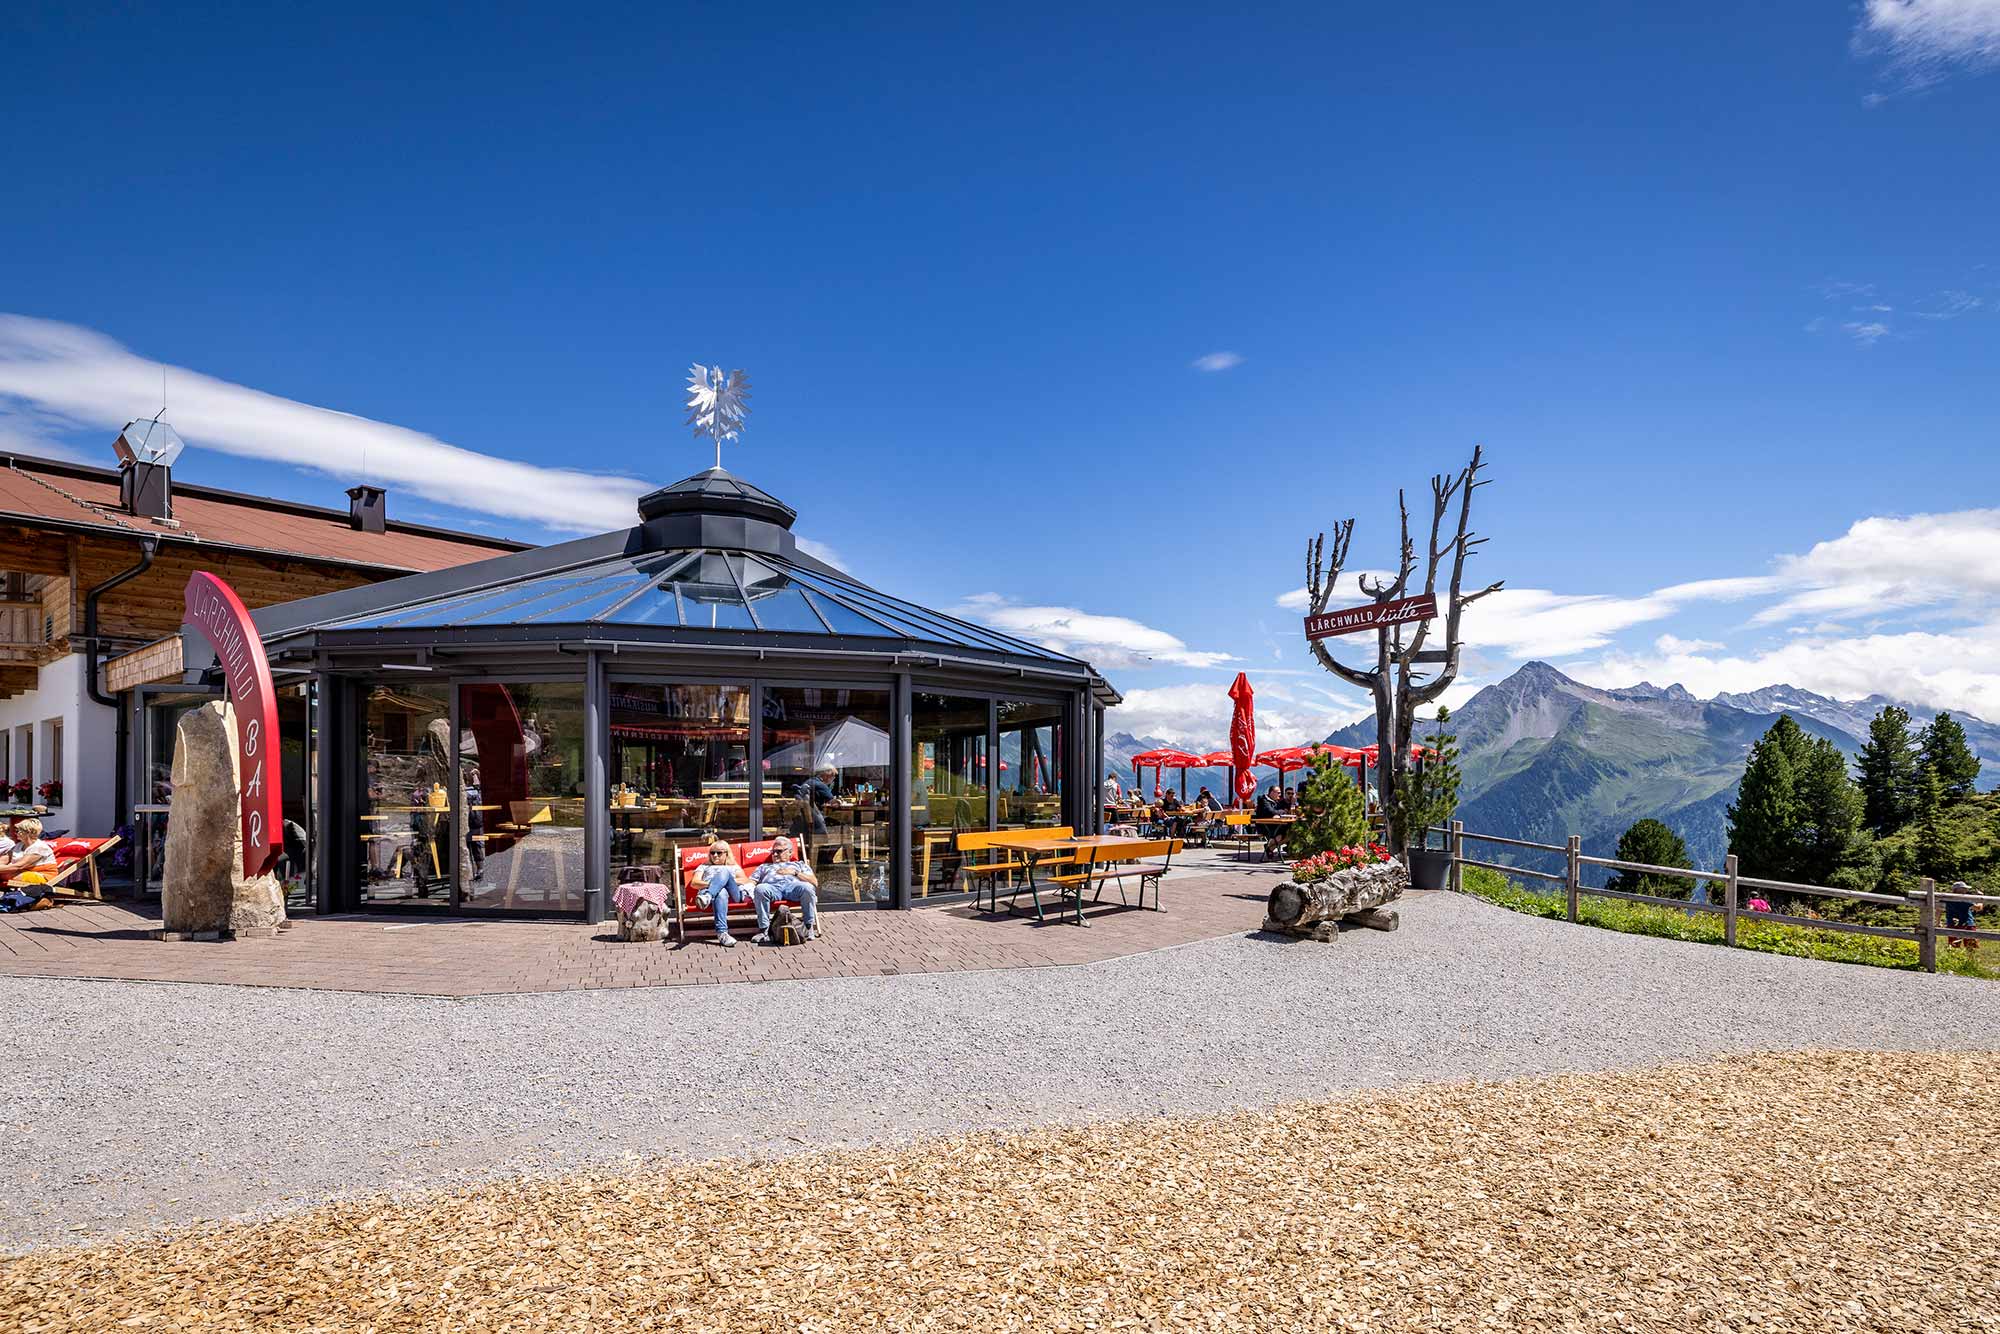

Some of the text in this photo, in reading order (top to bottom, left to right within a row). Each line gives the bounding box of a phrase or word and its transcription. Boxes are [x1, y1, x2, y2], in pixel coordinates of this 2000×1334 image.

[1310, 600, 1432, 632] LÄRCHWALD hütte
[193, 584, 262, 848] LÄRCHWALD BAR
